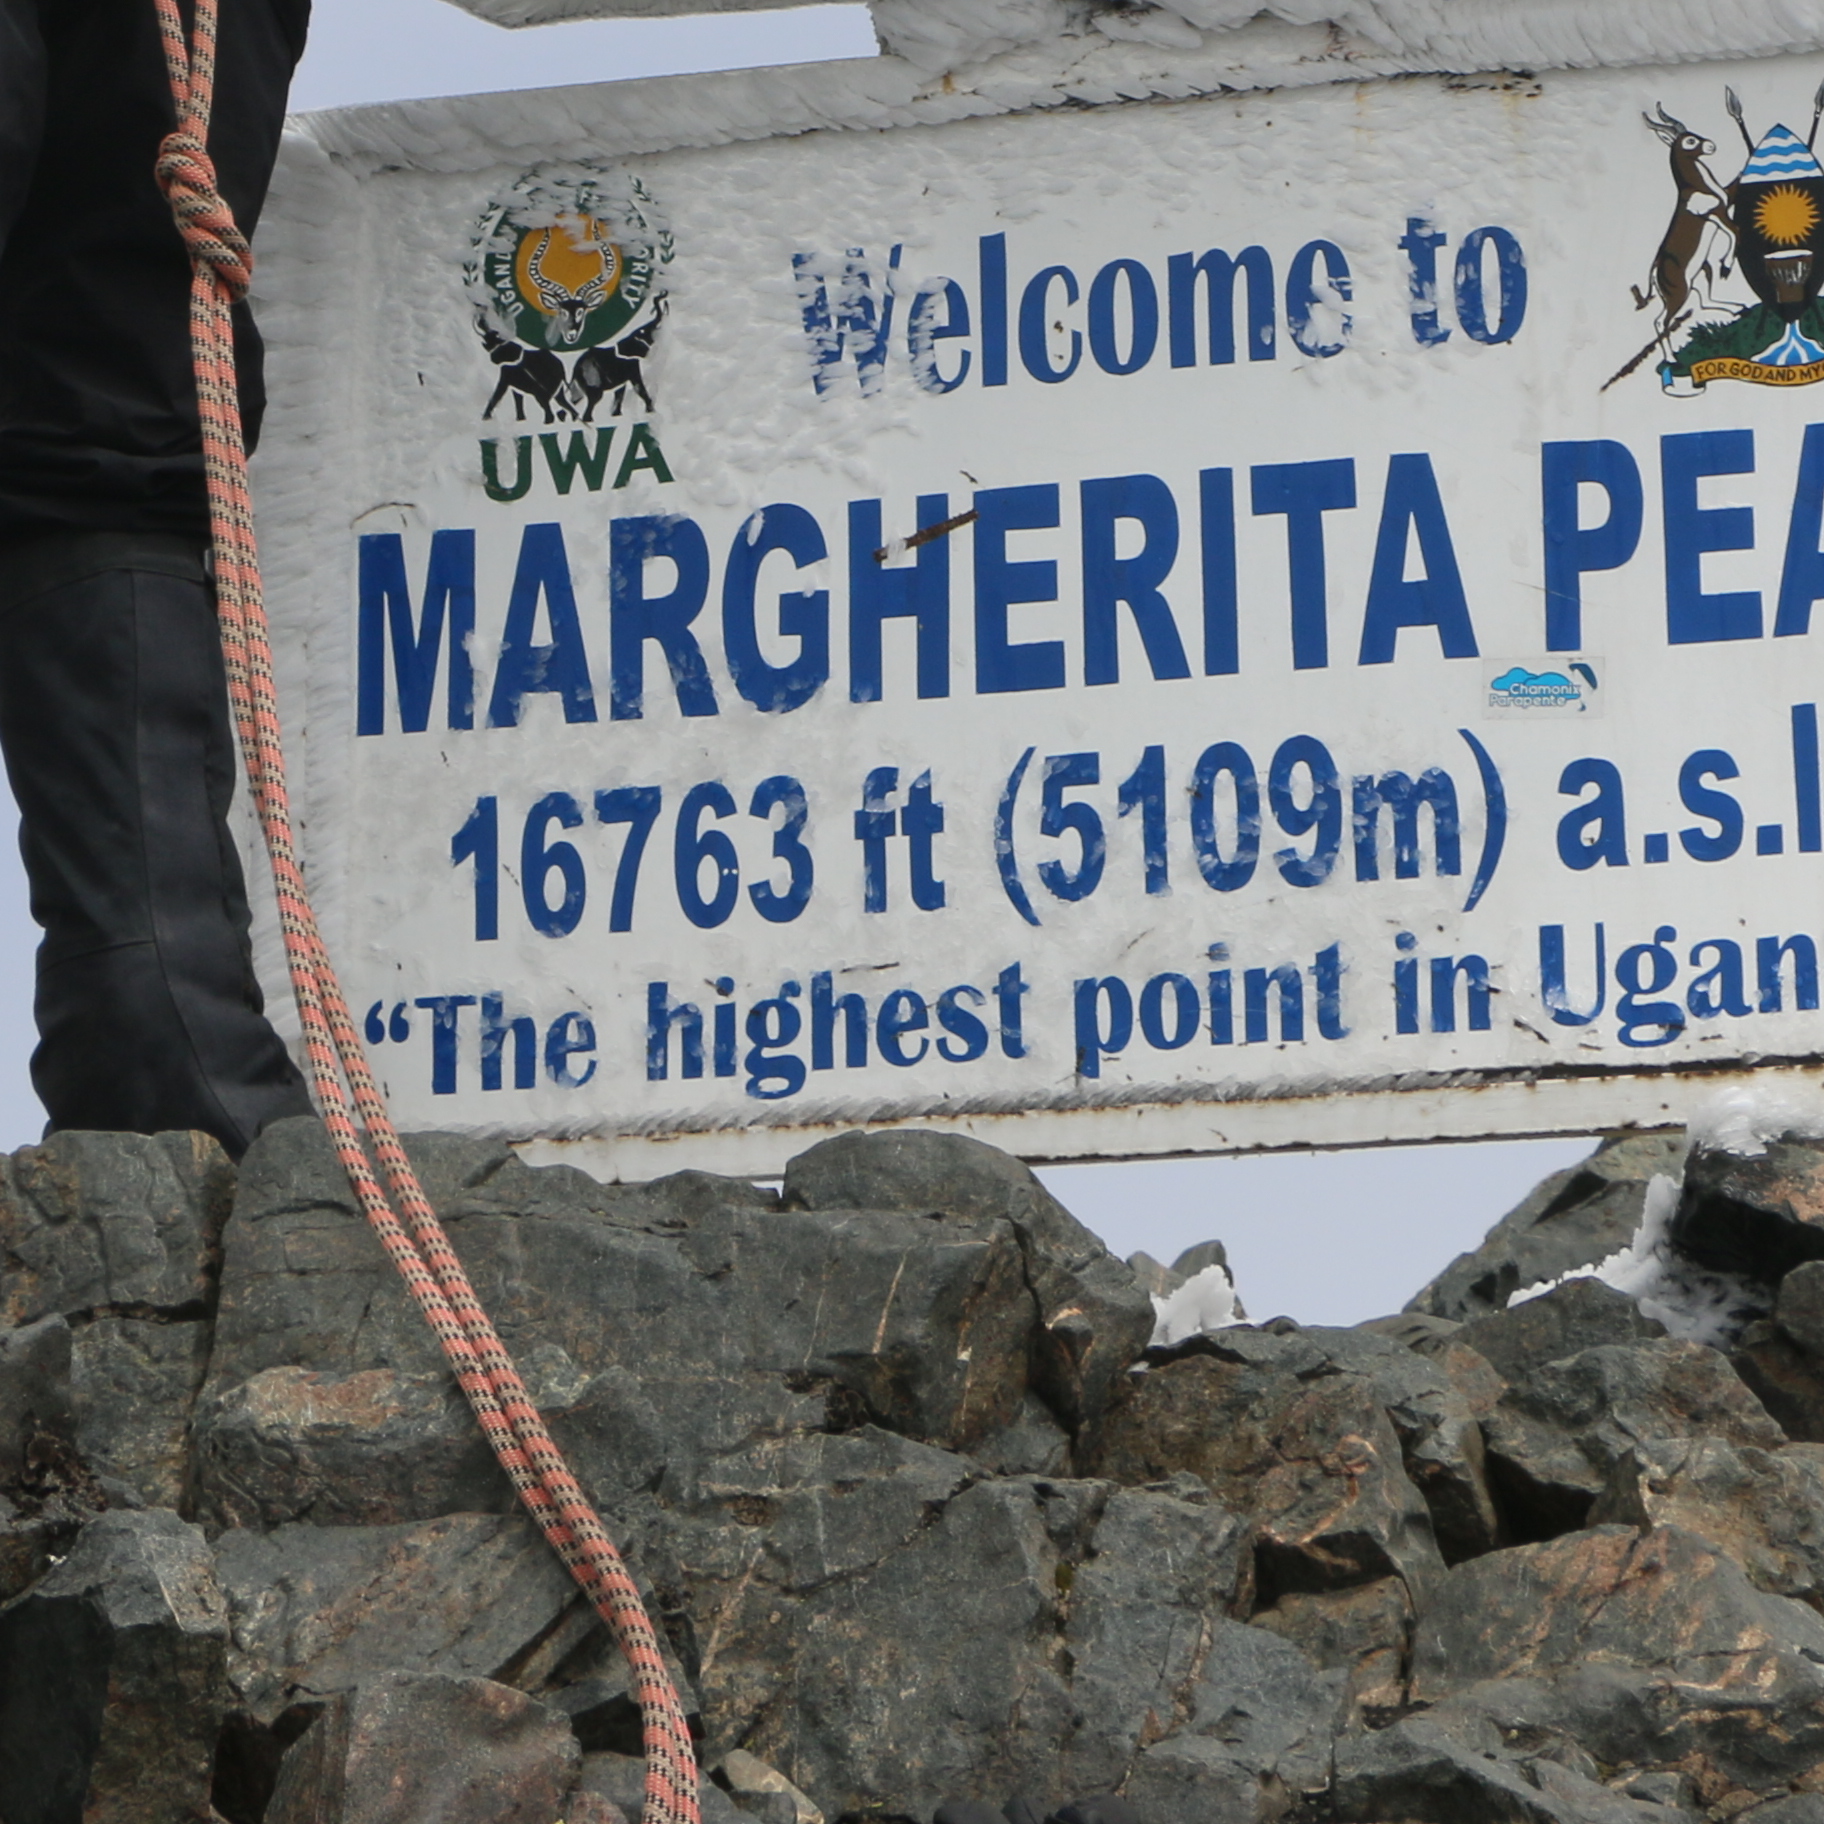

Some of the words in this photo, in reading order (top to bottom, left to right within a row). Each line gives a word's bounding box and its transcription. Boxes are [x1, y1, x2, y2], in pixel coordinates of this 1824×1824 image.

[794, 232, 1349, 391] Welcome
[1400, 217, 1527, 344] to
[1696, 363, 1728, 382] FOR
[1729, 363, 1763, 379] GOD
[1764, 368, 1796, 382] AND
[481, 423, 673, 501] UWA
[359, 453, 1479, 735] MARGHERITA
[1489, 694, 1567, 709] Parapente
[1509, 682, 1581, 695] Chamonix
[453, 775, 813, 939] 16763
[855, 767, 945, 912] ft
[997, 729, 1507, 925] (5109m)
[1558, 703, 1821, 869] a.s.l
[648, 962, 1029, 1097] highest
[1075, 943, 1348, 1077] point
[1395, 932, 1491, 1033] in
